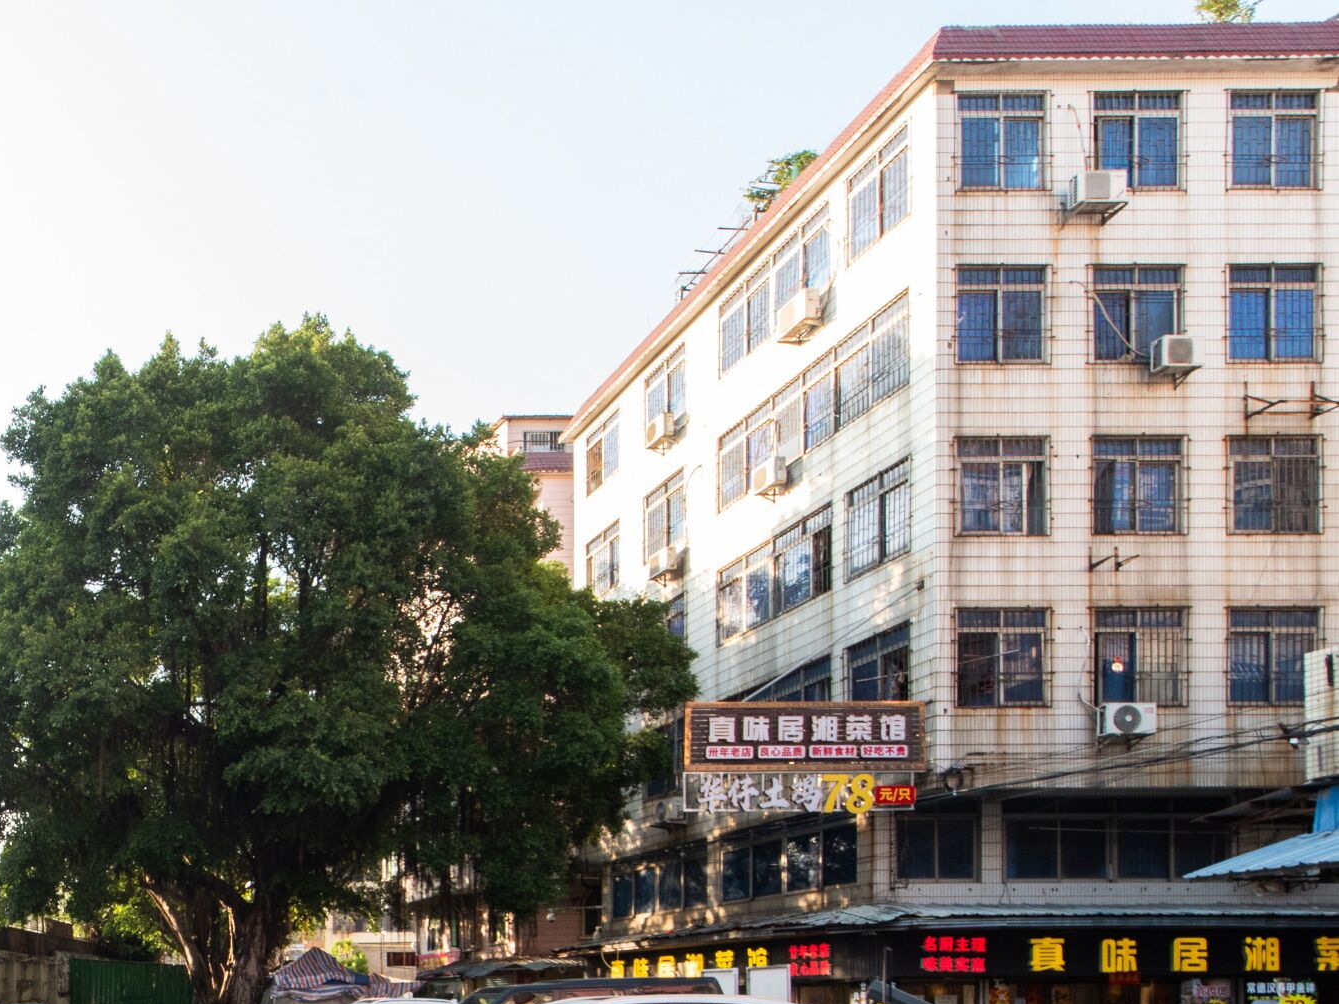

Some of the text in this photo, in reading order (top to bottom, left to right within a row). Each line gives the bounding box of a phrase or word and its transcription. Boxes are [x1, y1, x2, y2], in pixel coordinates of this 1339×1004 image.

[708, 714, 906, 742] 真味居湘菜馆
[760, 746, 803, 758] 良心品质
[811, 746, 857, 757] 新鲜食材
[863, 745, 906, 757] 好吃不贵
[821, 773, 875, 814] 78
[879, 788, 911, 801] 元/只
[1029, 936, 1339, 973] 真味居湘菜
